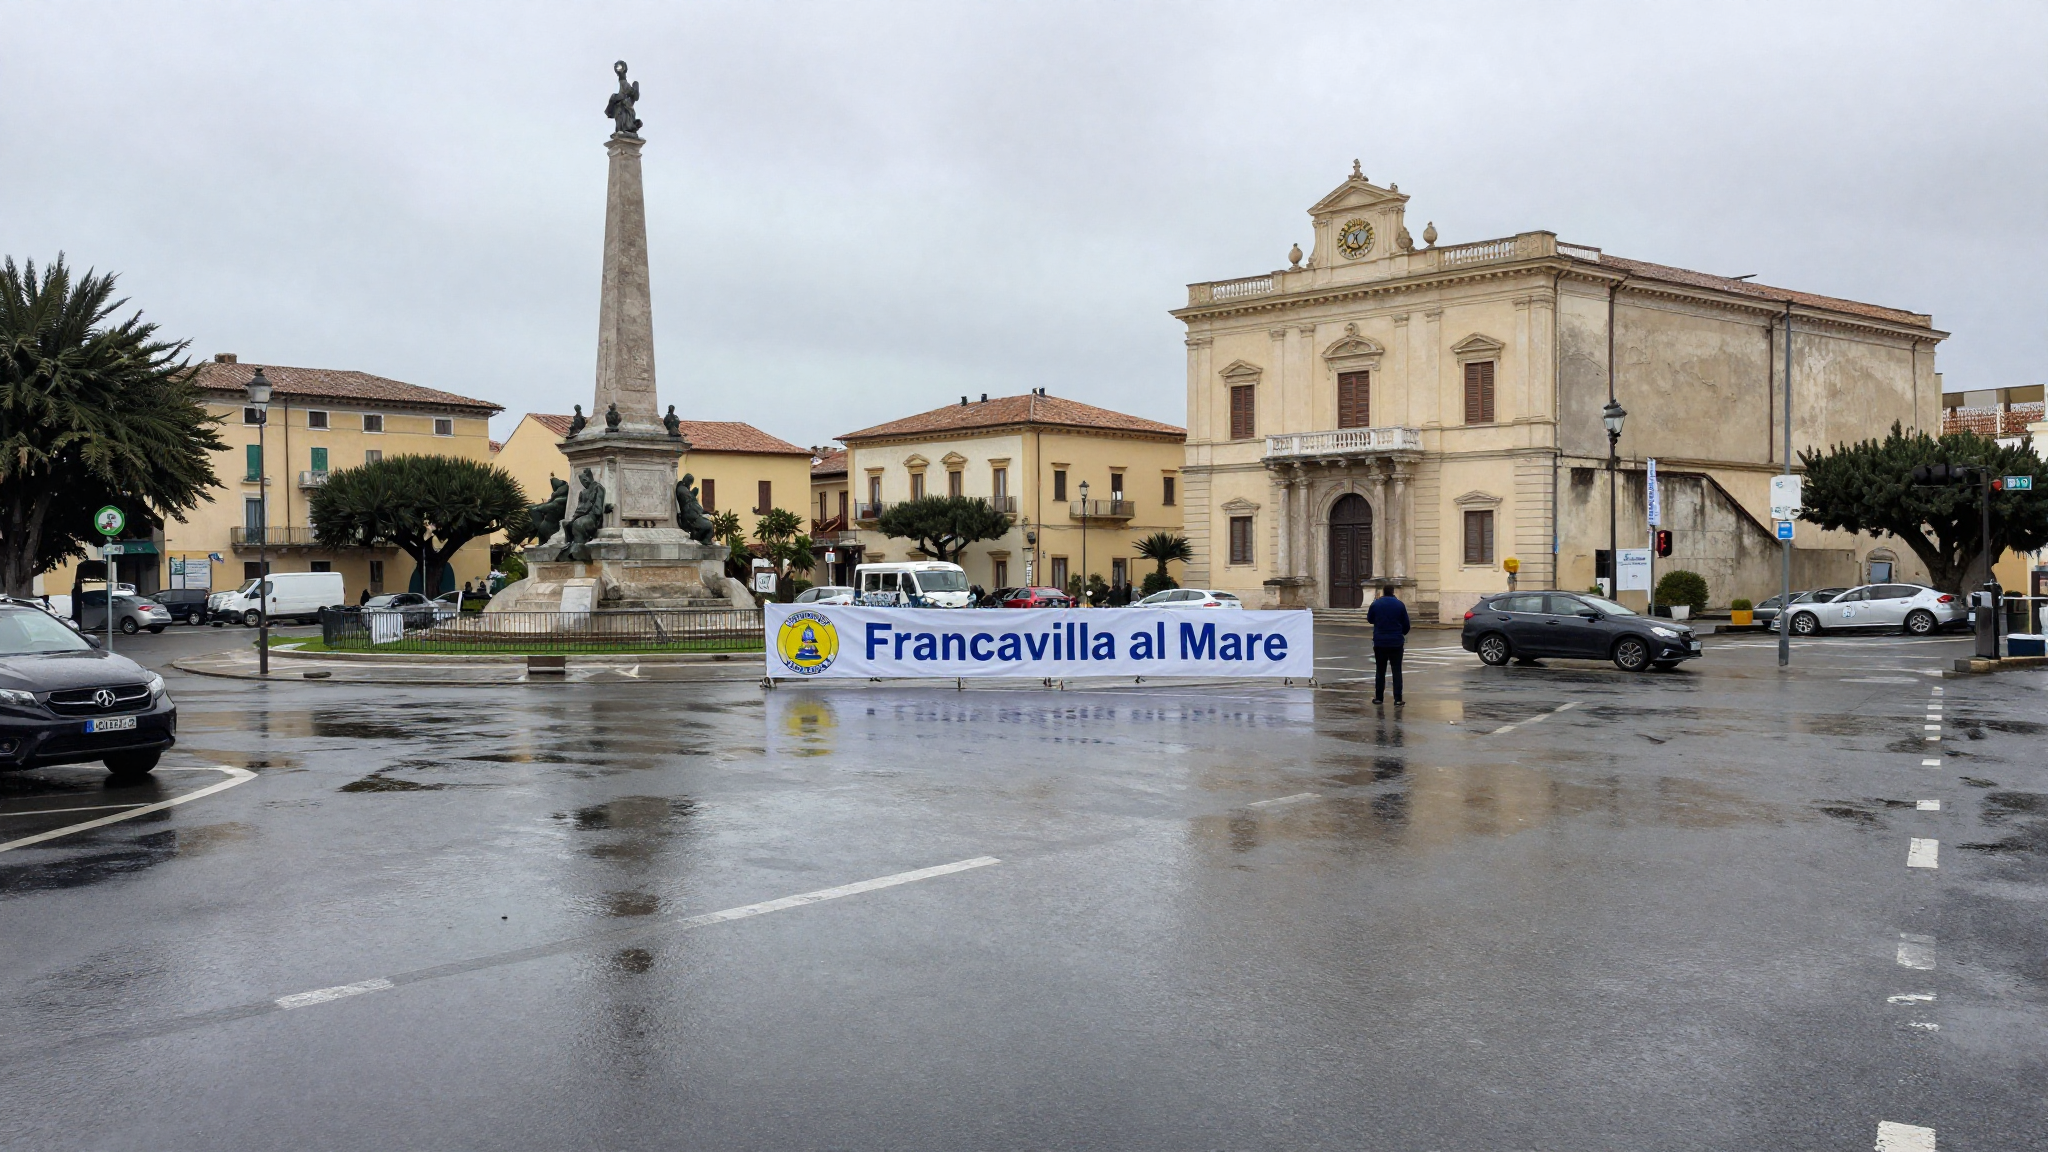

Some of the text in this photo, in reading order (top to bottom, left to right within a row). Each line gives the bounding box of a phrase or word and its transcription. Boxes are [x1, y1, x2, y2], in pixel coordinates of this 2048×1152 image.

[865, 621, 1289, 662] Francavilla al Mare
